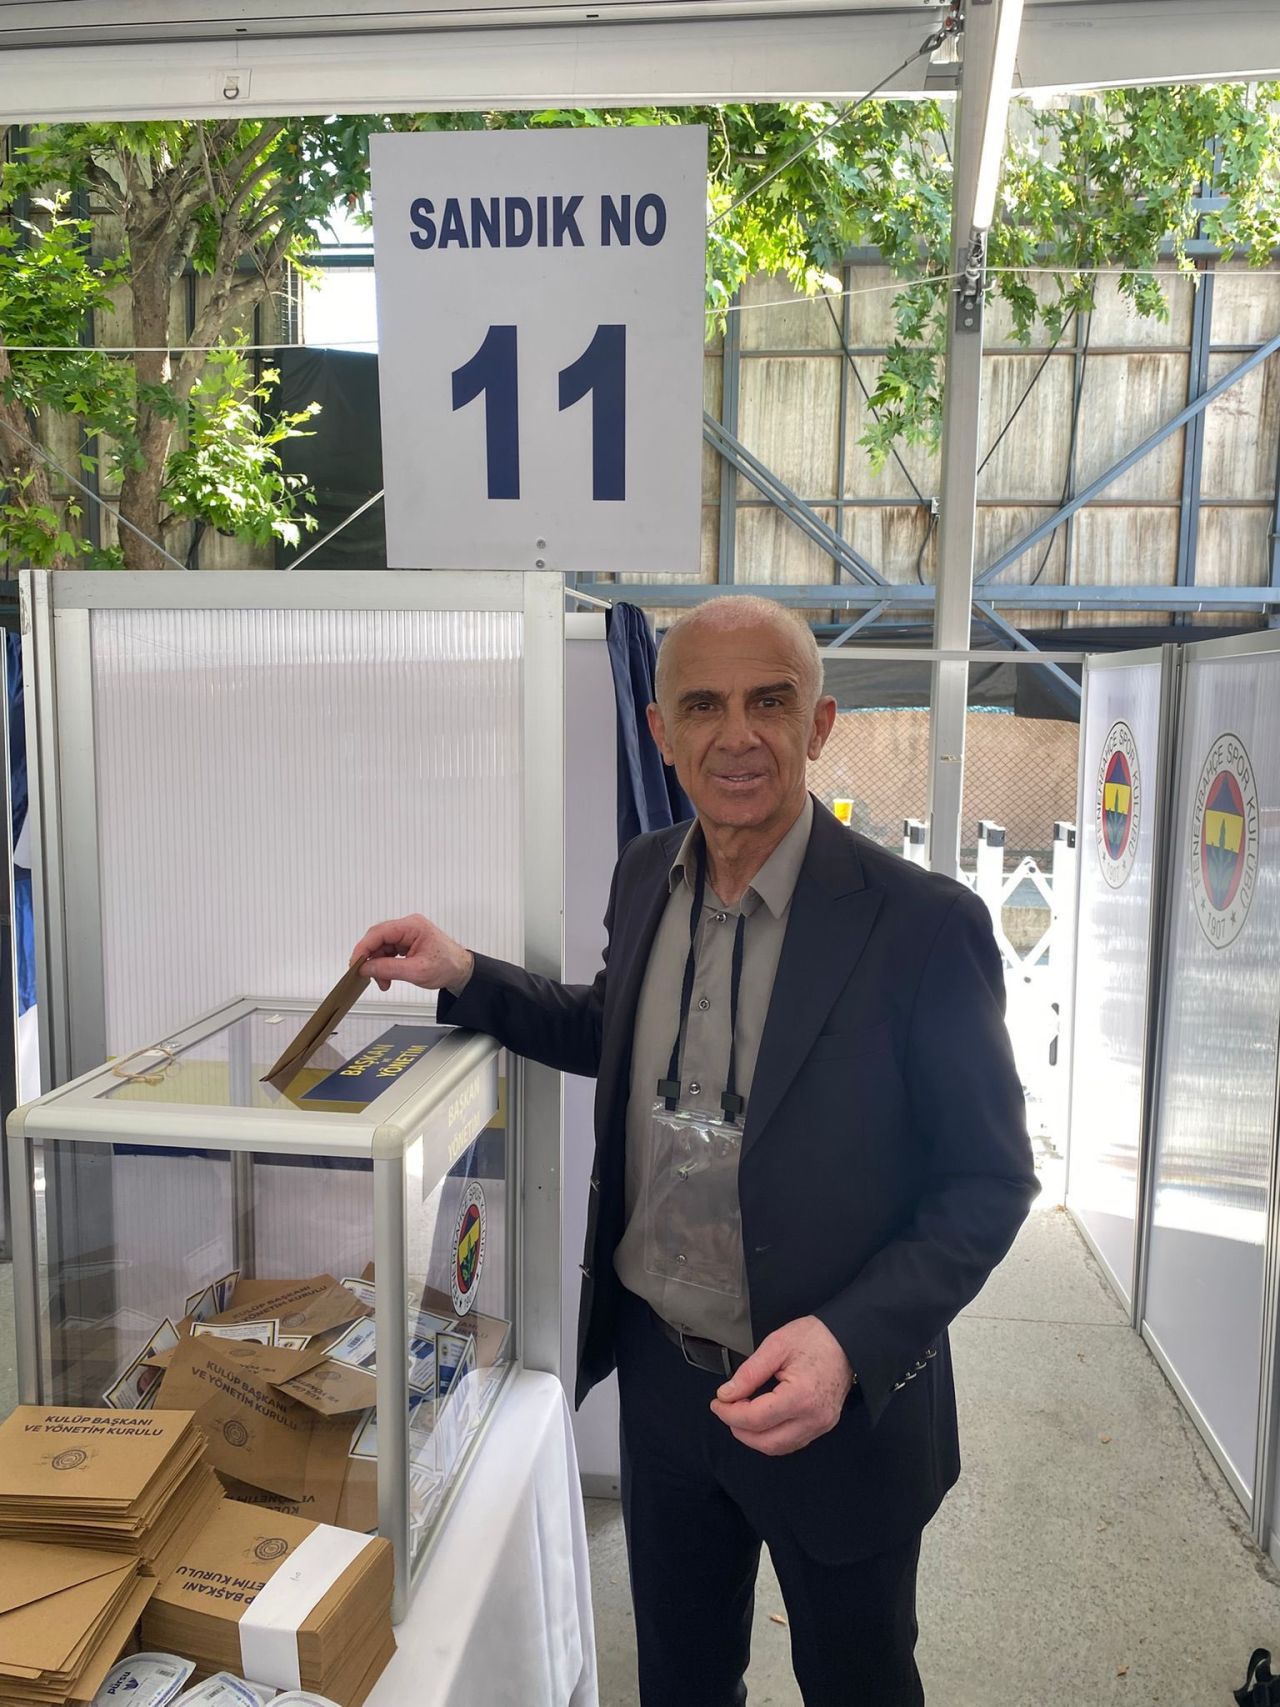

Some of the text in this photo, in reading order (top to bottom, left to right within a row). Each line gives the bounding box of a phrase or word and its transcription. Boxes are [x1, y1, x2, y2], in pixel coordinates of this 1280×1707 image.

[410, 193, 667, 250] SANDIK NO
[451, 324, 627, 500] 11
[1226, 743, 1250, 791] SPOR
[1207, 912, 1226, 940] 1907
[340, 1044, 395, 1077] BAŞKAN
[376, 1045, 429, 1078] YÖNETİM
[191, 1366, 207, 1380] VE
[208, 1375, 254, 1408] YÖNETİM
[254, 1402, 298, 1431] KURULU
[206, 1360, 240, 1385] KULÜP
[241, 1381, 287, 1413] BAŞKANI
[44, 1424, 104, 1434] YÖNETİM
[106, 1428, 163, 1436] KURULU
[45, 1414, 153, 1426] KULÜP BAŞKANI
[176, 1565, 266, 1592] ETİM KURULU
[182, 1581, 244, 1602] BAŞKANI
